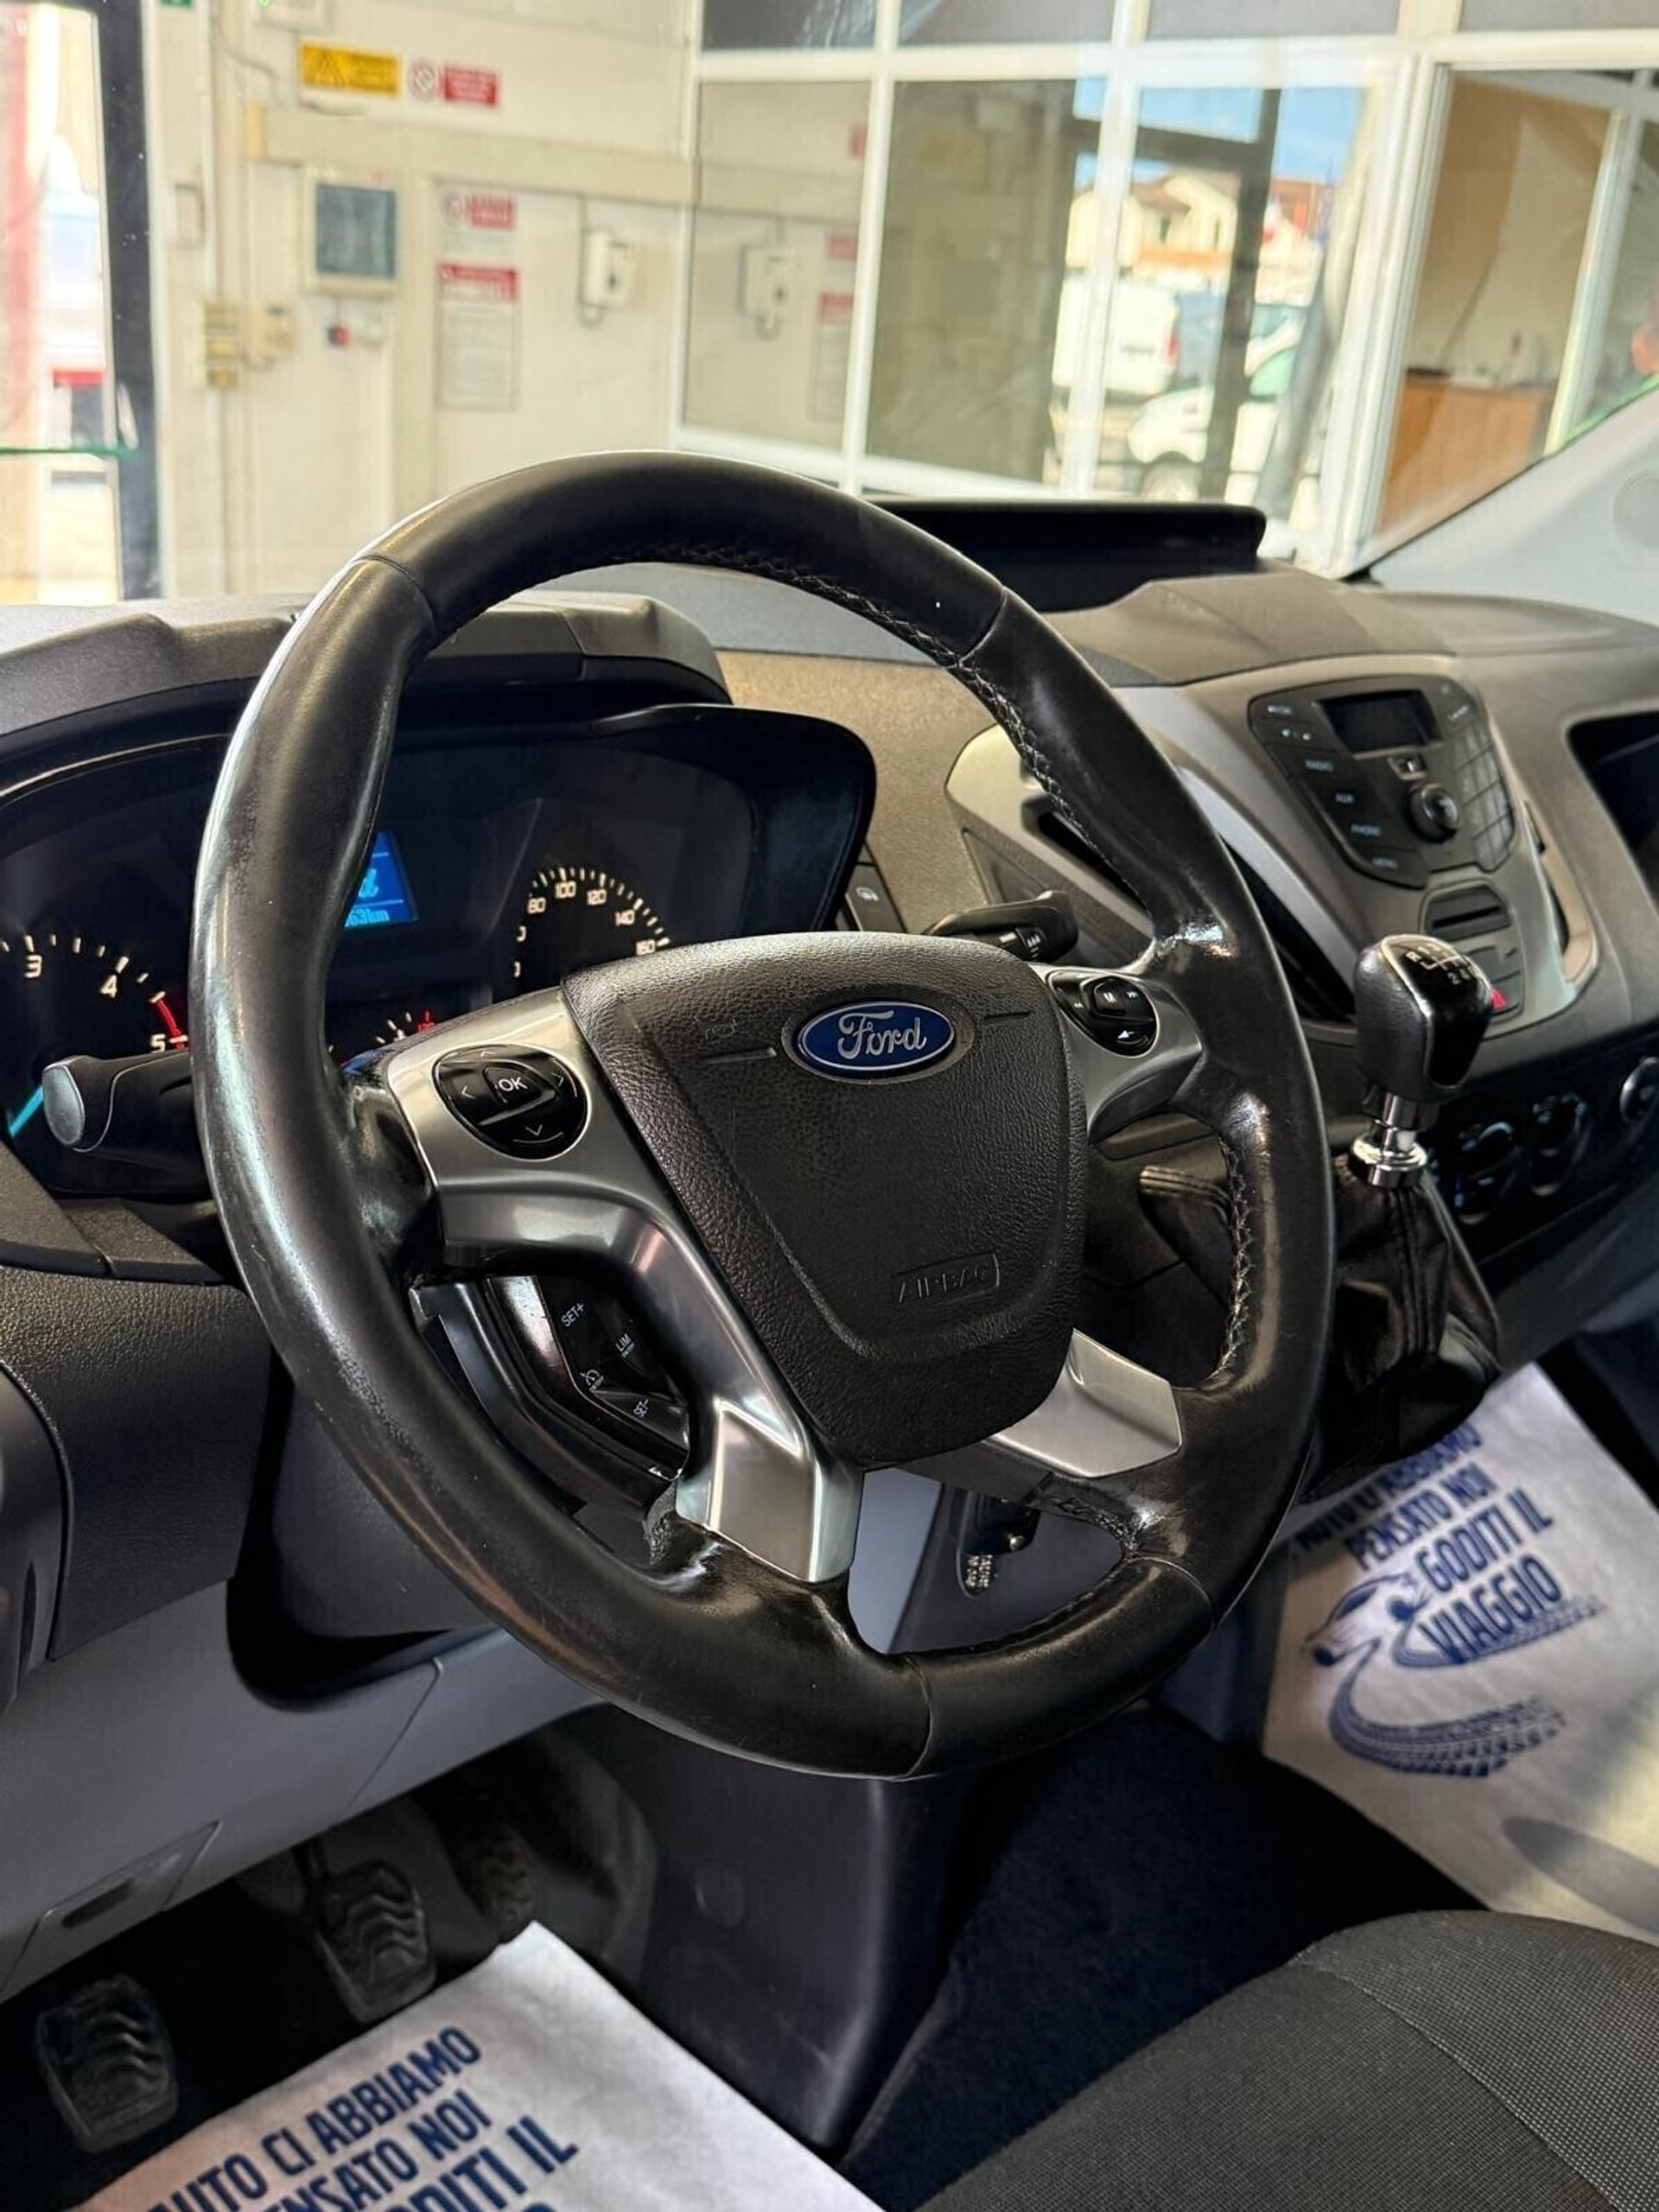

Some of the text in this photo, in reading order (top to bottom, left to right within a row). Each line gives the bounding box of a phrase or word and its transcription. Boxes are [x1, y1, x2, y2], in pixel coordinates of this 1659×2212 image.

[555, 880, 577, 899] 100
[614, 909, 636, 928] 140
[23, 954, 43, 979] 3
[99, 974, 118, 999] 4
[149, 1033, 166, 1054] 5
[836, 1010, 929, 1061] Ford
[498, 1076, 529, 1093] OK
[561, 1301, 586, 1328] SET+
[1343, 1490, 1453, 1572] PENSATO
[1415, 1486, 1554, 1593] GODITI IL
[1417, 1553, 1562, 1665] VIAGGIO
[148, 2024, 482, 2212] UTO CI ABBIAMO
[408, 2088, 493, 2162] NOI
[505, 2114, 579, 2175] IL
